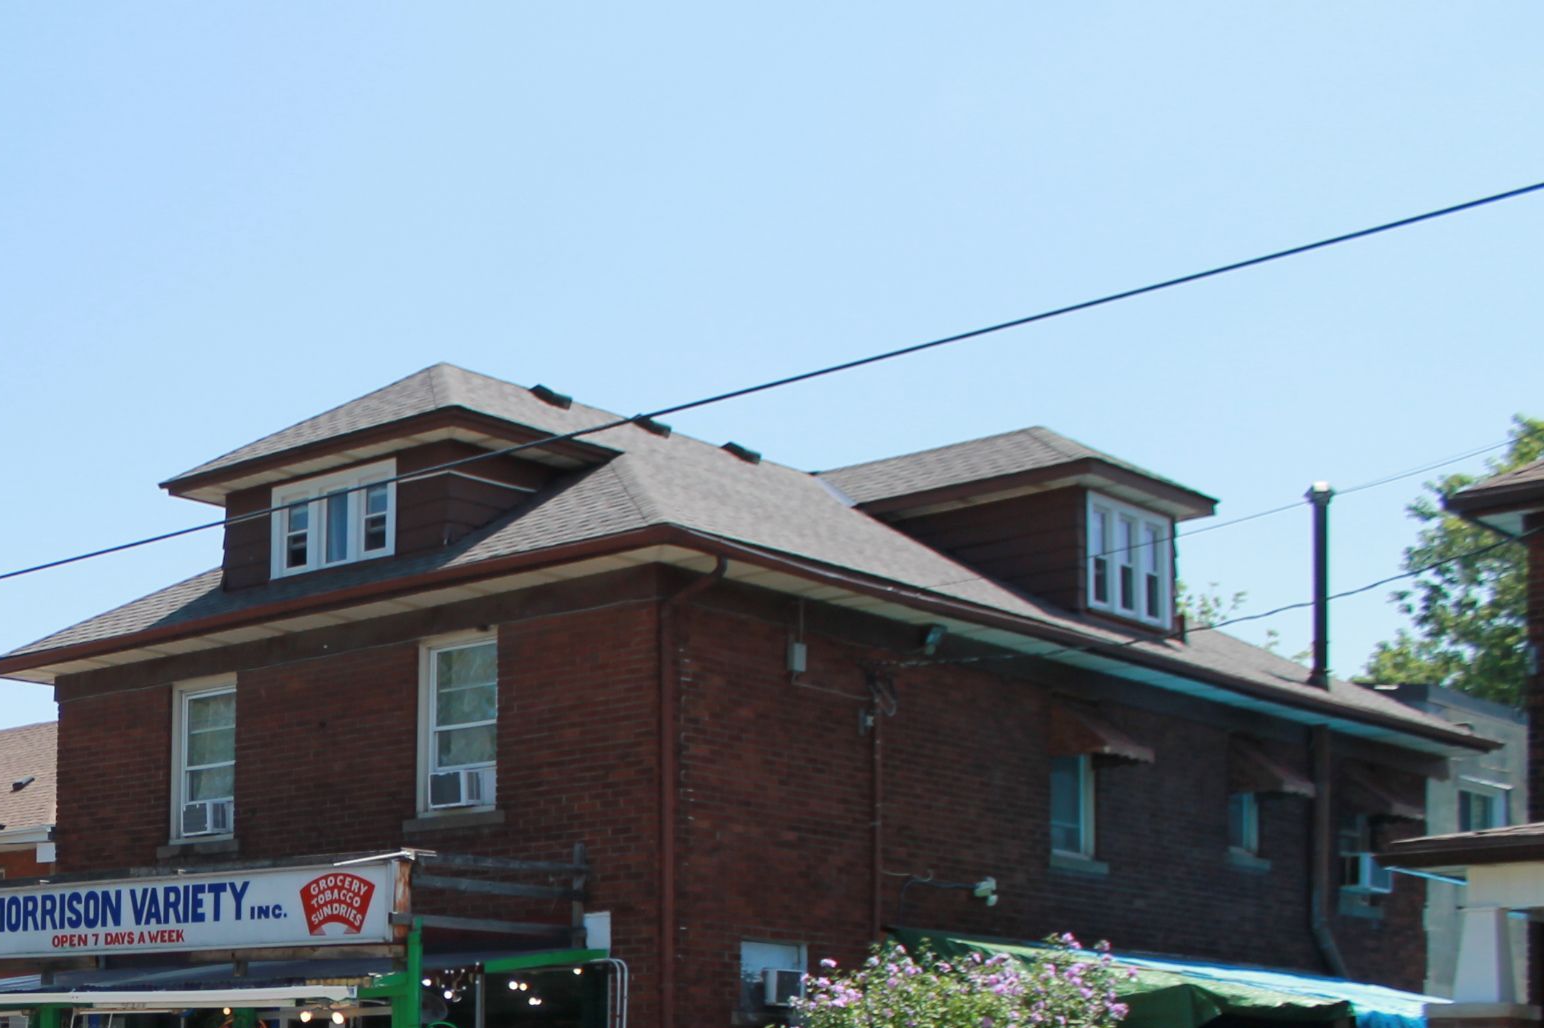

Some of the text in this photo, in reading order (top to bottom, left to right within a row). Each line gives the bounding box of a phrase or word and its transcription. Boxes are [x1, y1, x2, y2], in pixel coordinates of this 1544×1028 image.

[310, 875, 369, 896] GROCERY
[129, 881, 250, 926] VARIETY
[250, 904, 288, 920] INC.
[311, 889, 361, 908] TOBACCO
[311, 903, 363, 926] SUNDRIES
[52, 929, 185, 948] OPEN 7 DAYS A WEEK
